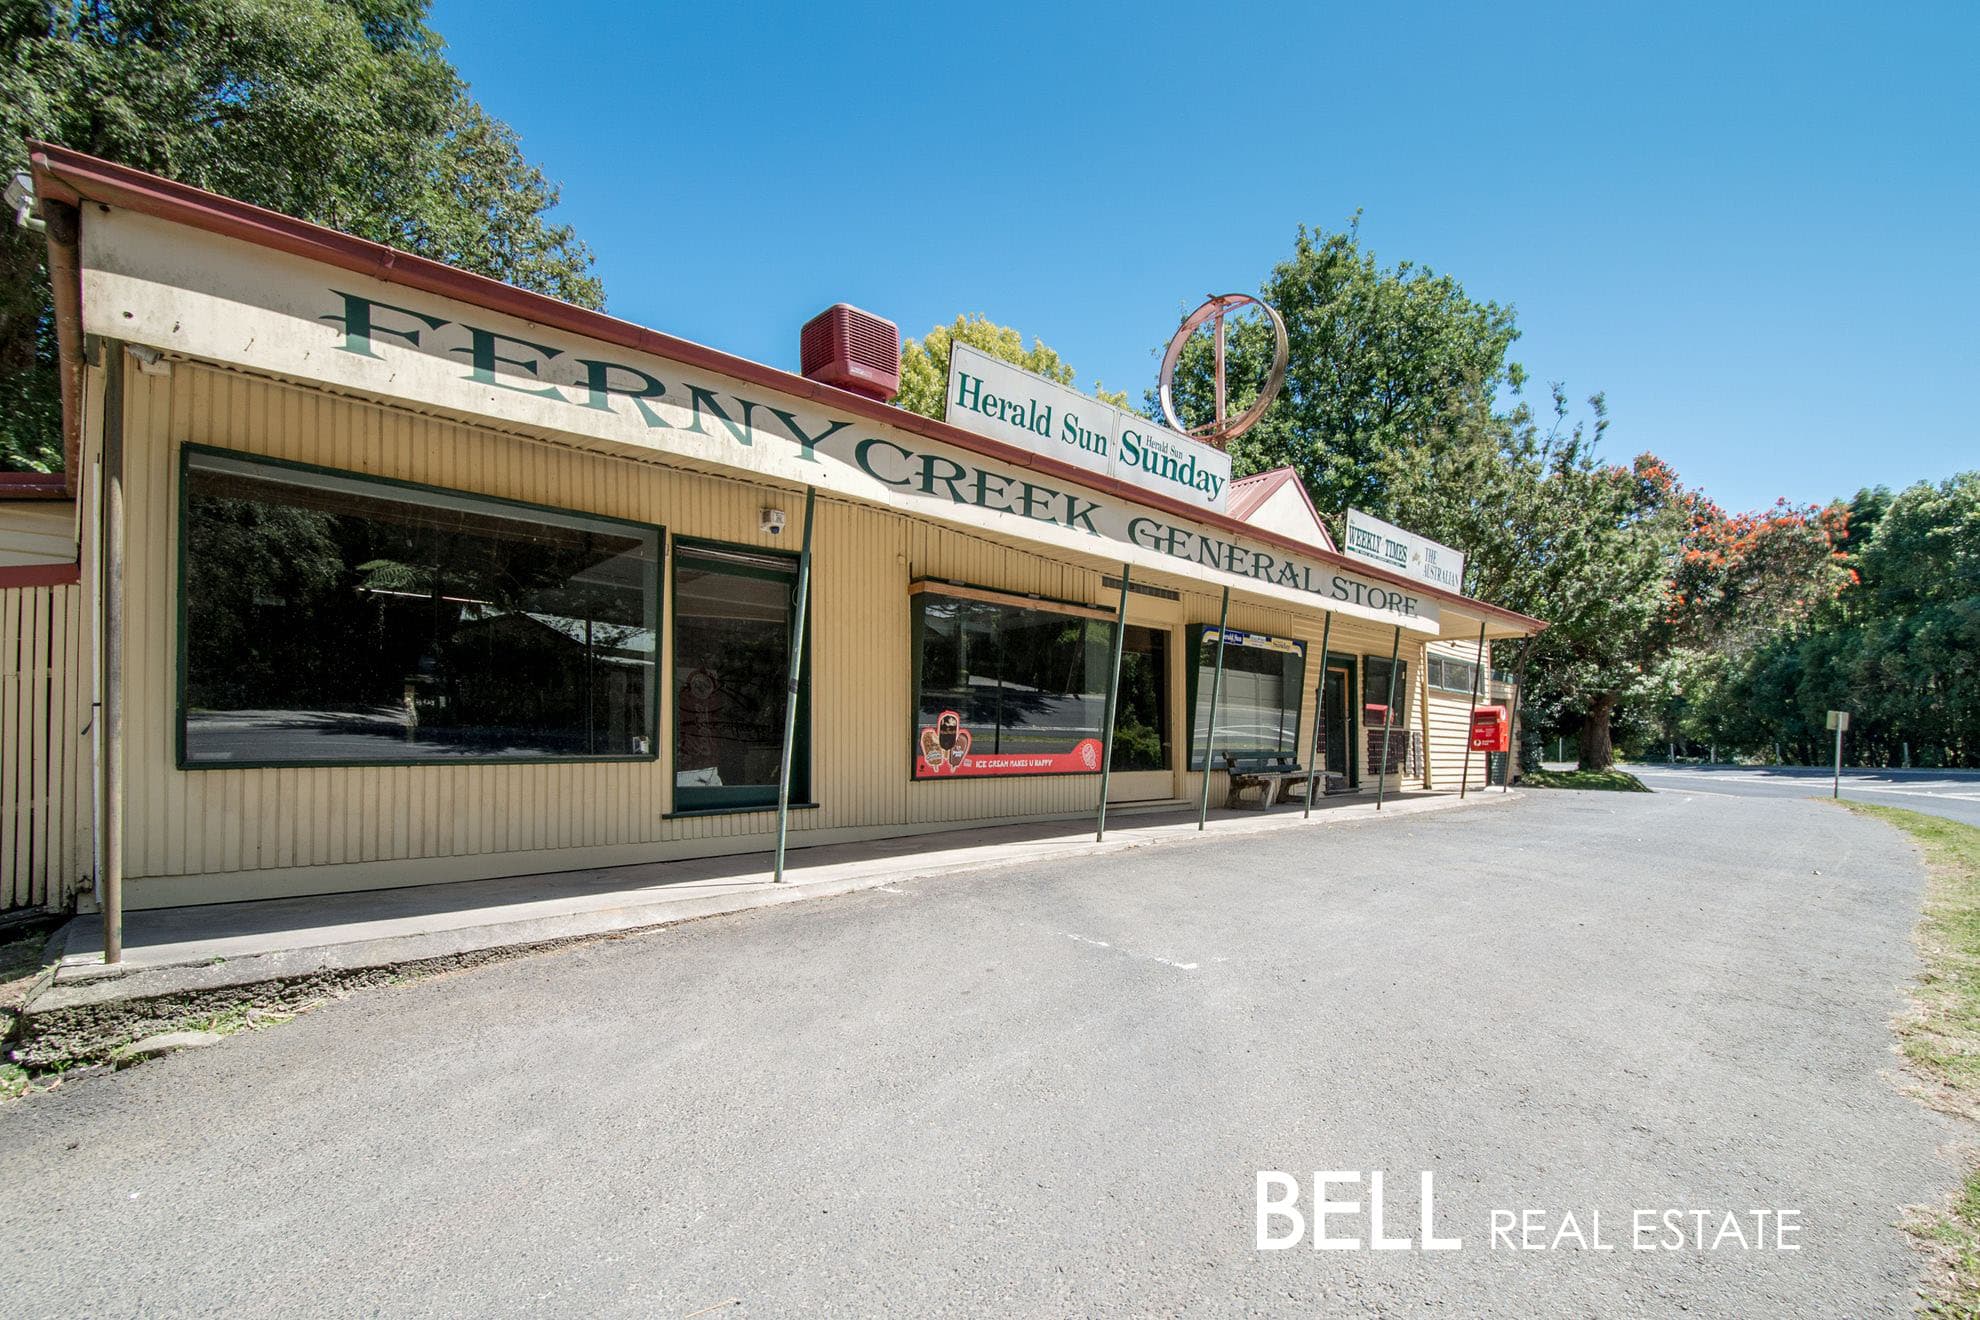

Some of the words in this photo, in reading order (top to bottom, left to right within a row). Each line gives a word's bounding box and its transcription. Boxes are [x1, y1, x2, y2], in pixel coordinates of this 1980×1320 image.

[955, 371, 1052, 438] Herald
[1062, 413, 1108, 457] Sun
[319, 289, 854, 464] FERNY
[855, 438, 1102, 537] CREEK
[1128, 517, 1323, 594] GENERAL
[1331, 576, 1418, 619] STORE
[1146, 435, 1169, 453] Herald
[1170, 445, 1183, 460] Sun
[1119, 430, 1225, 502] Sunday
[1349, 525, 1382, 553] WEEKLY
[1385, 539, 1408, 563] TIMES
[1425, 547, 1437, 565] THE
[1424, 564, 1459, 587] AUSTRALIAN
[976, 760, 987, 768] ICE
[988, 760, 1008, 768] CREAM
[1009, 759, 1028, 767] MAKES
[1029, 759, 1034, 767] U
[1034, 759, 1053, 767] HAPPY
